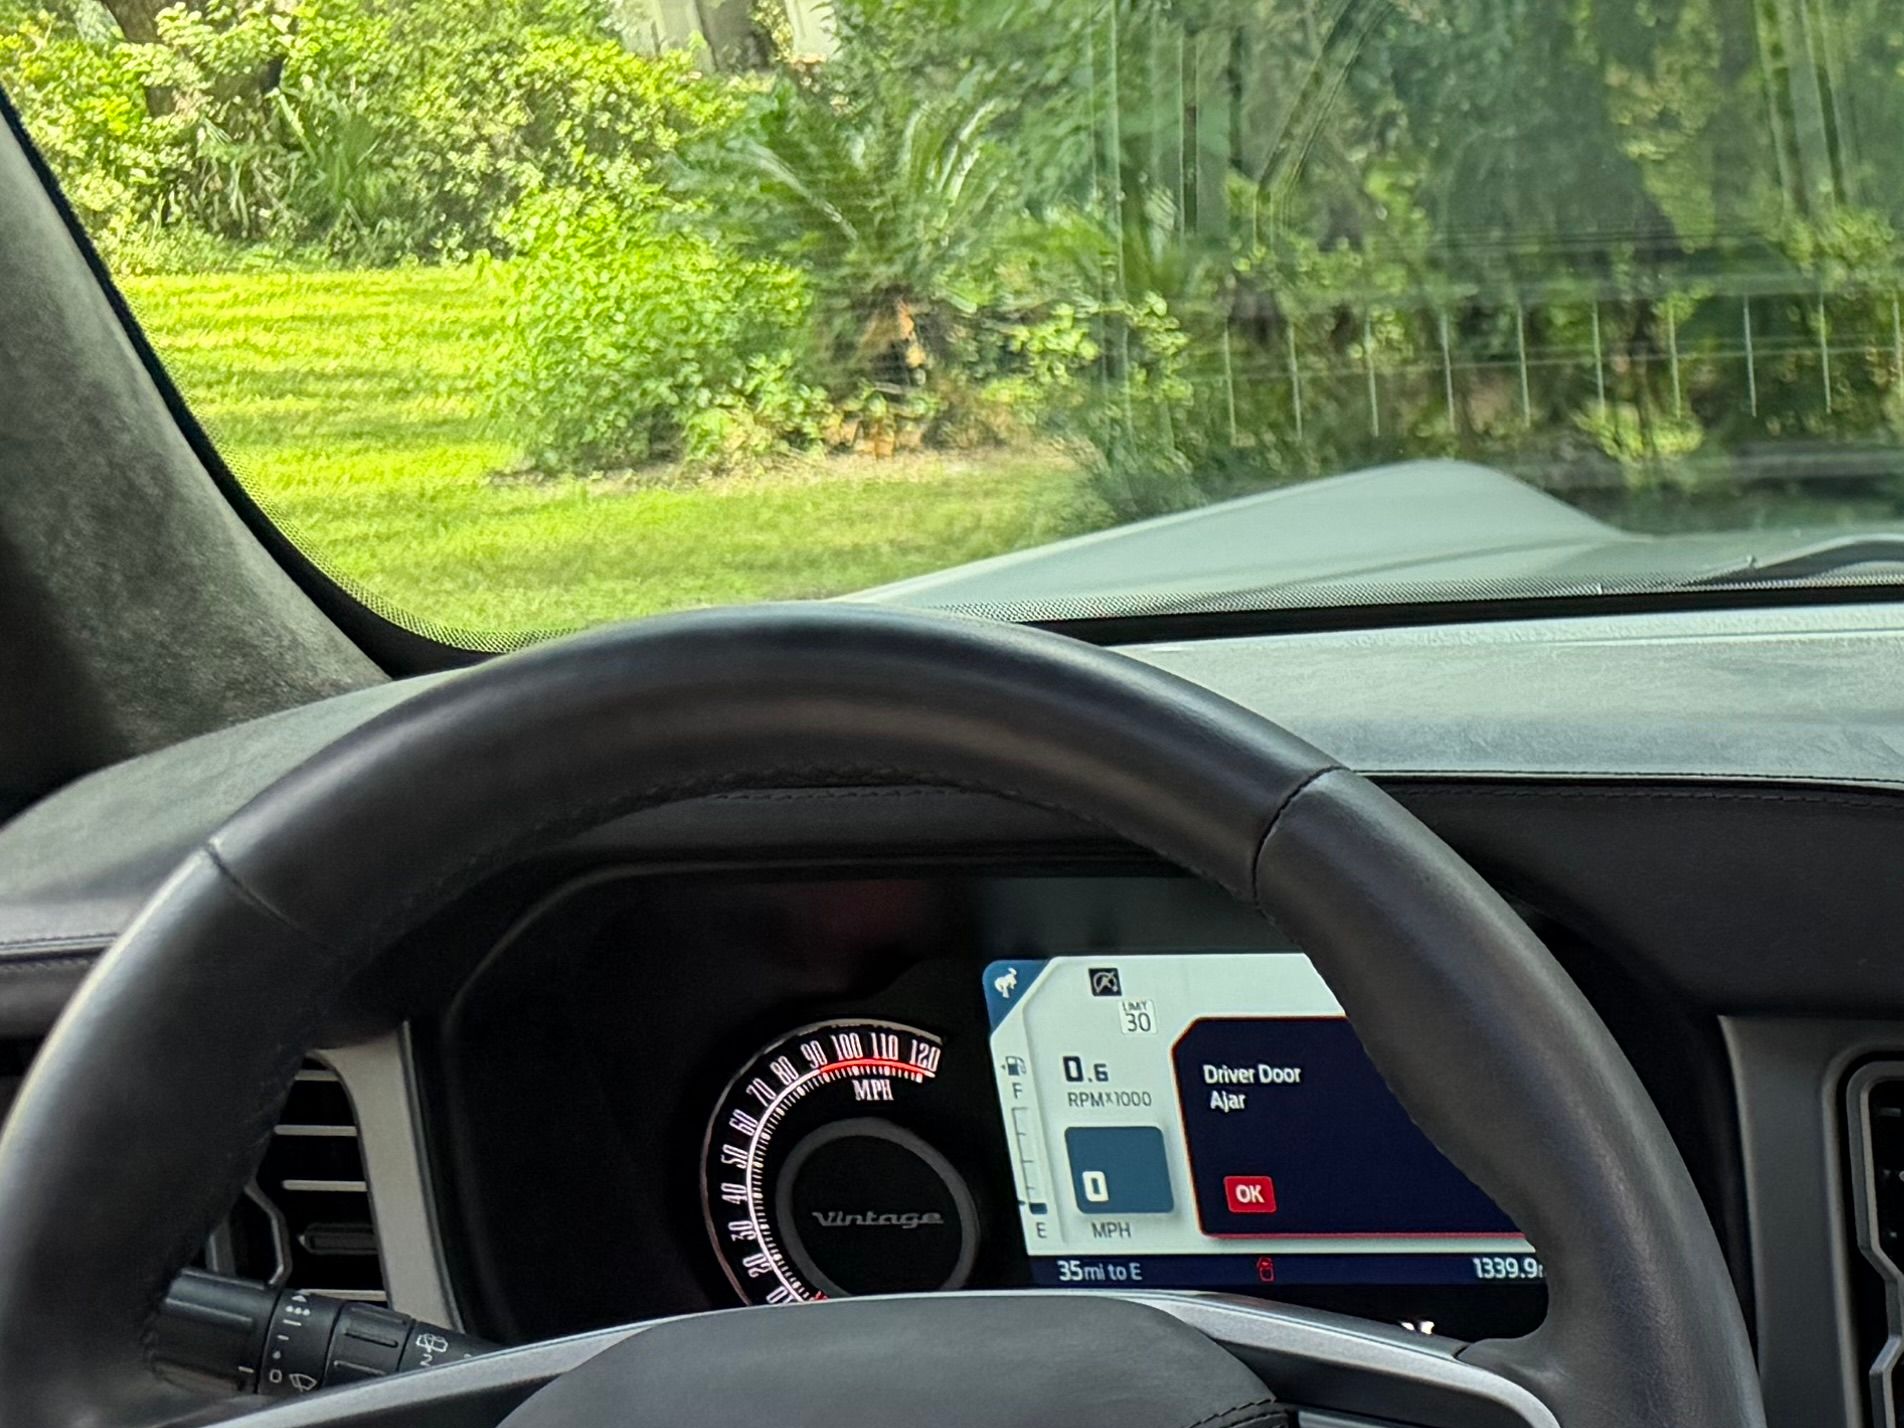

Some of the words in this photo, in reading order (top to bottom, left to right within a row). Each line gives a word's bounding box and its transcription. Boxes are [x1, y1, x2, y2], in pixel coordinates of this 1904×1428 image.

[1125, 1012, 1151, 1032] 30
[800, 1040, 828, 1069] 90
[830, 1032, 863, 1061] 100
[870, 1032, 899, 1060] 110
[909, 1039, 941, 1072] 120
[769, 1055, 799, 1085] 80
[1062, 1056, 1109, 1083] 0.6
[1203, 1064, 1256, 1085] Driver
[1258, 1064, 1301, 1085] Door
[746, 1077, 777, 1106] 70
[852, 1078, 894, 1101] MPH
[1012, 1083, 1023, 1099] F
[1210, 1090, 1246, 1113] Ajar
[729, 1108, 758, 1136] 60
[721, 1144, 749, 1168] 50
[721, 1182, 748, 1205] 40
[1082, 1170, 1109, 1202] 0
[1235, 1184, 1264, 1203] OK
[728, 1220, 756, 1242] 30
[812, 1211, 944, 1229] Vintage
[1036, 1222, 1047, 1239] E
[1091, 1221, 1131, 1239] MPH
[1107, 1263, 1127, 1281] to
[1129, 1262, 1143, 1281] E
